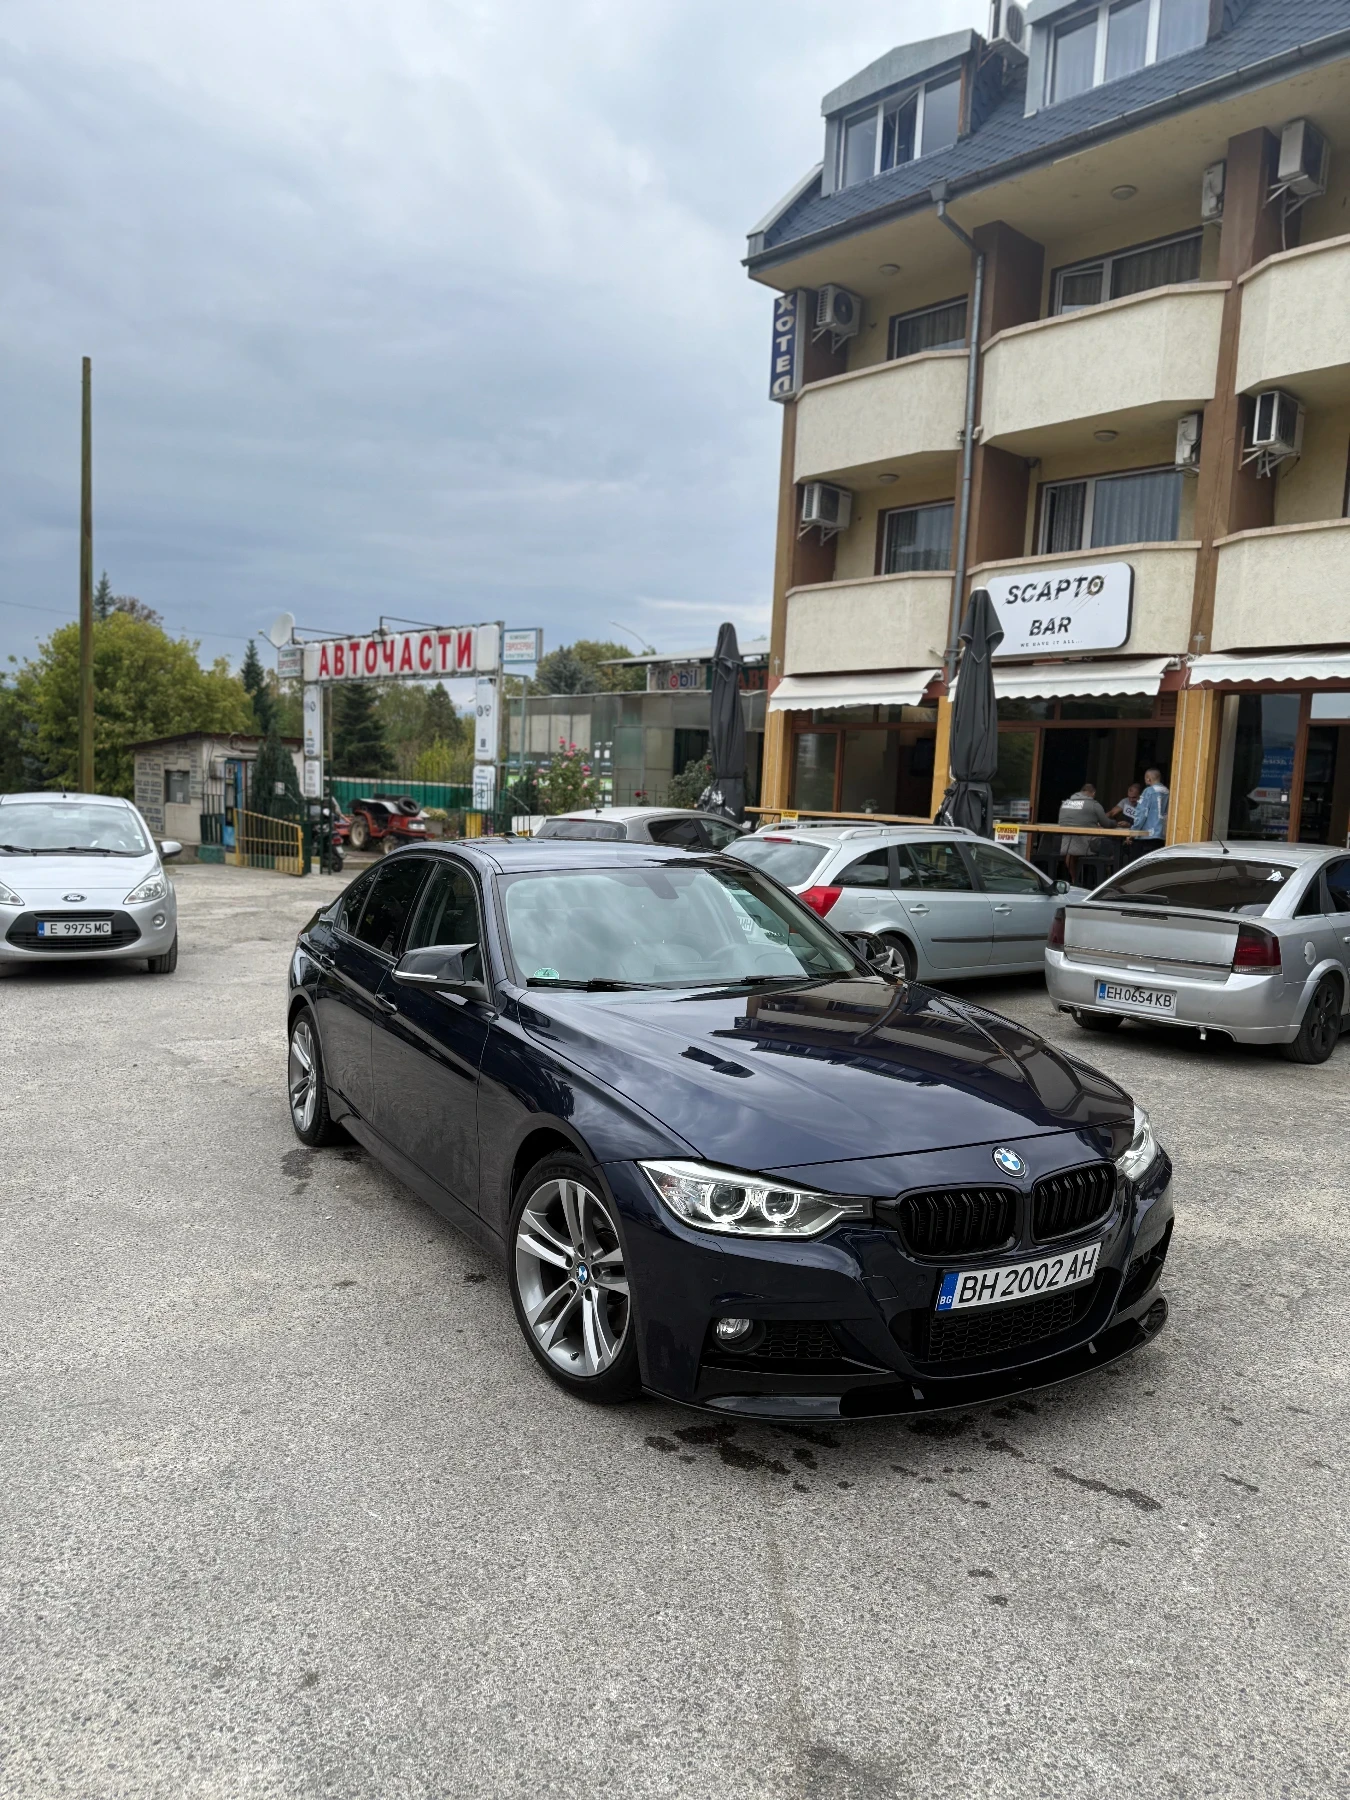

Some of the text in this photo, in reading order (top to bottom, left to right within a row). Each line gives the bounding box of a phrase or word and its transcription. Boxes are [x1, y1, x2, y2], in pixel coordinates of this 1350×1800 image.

[772, 294, 795, 396] ХОТЕЛ
[1003, 574, 1106, 606] SCAPTO
[1028, 616, 1072, 637] BAR
[318, 631, 472, 677] АВТОЧАСТИ
[50, 922, 110, 934] E 9975 MC
[1106, 986, 1172, 1008] EH 0654 KB
[958, 1247, 1097, 1304] BH 2002 AH
[939, 1296, 952, 1305] BG
